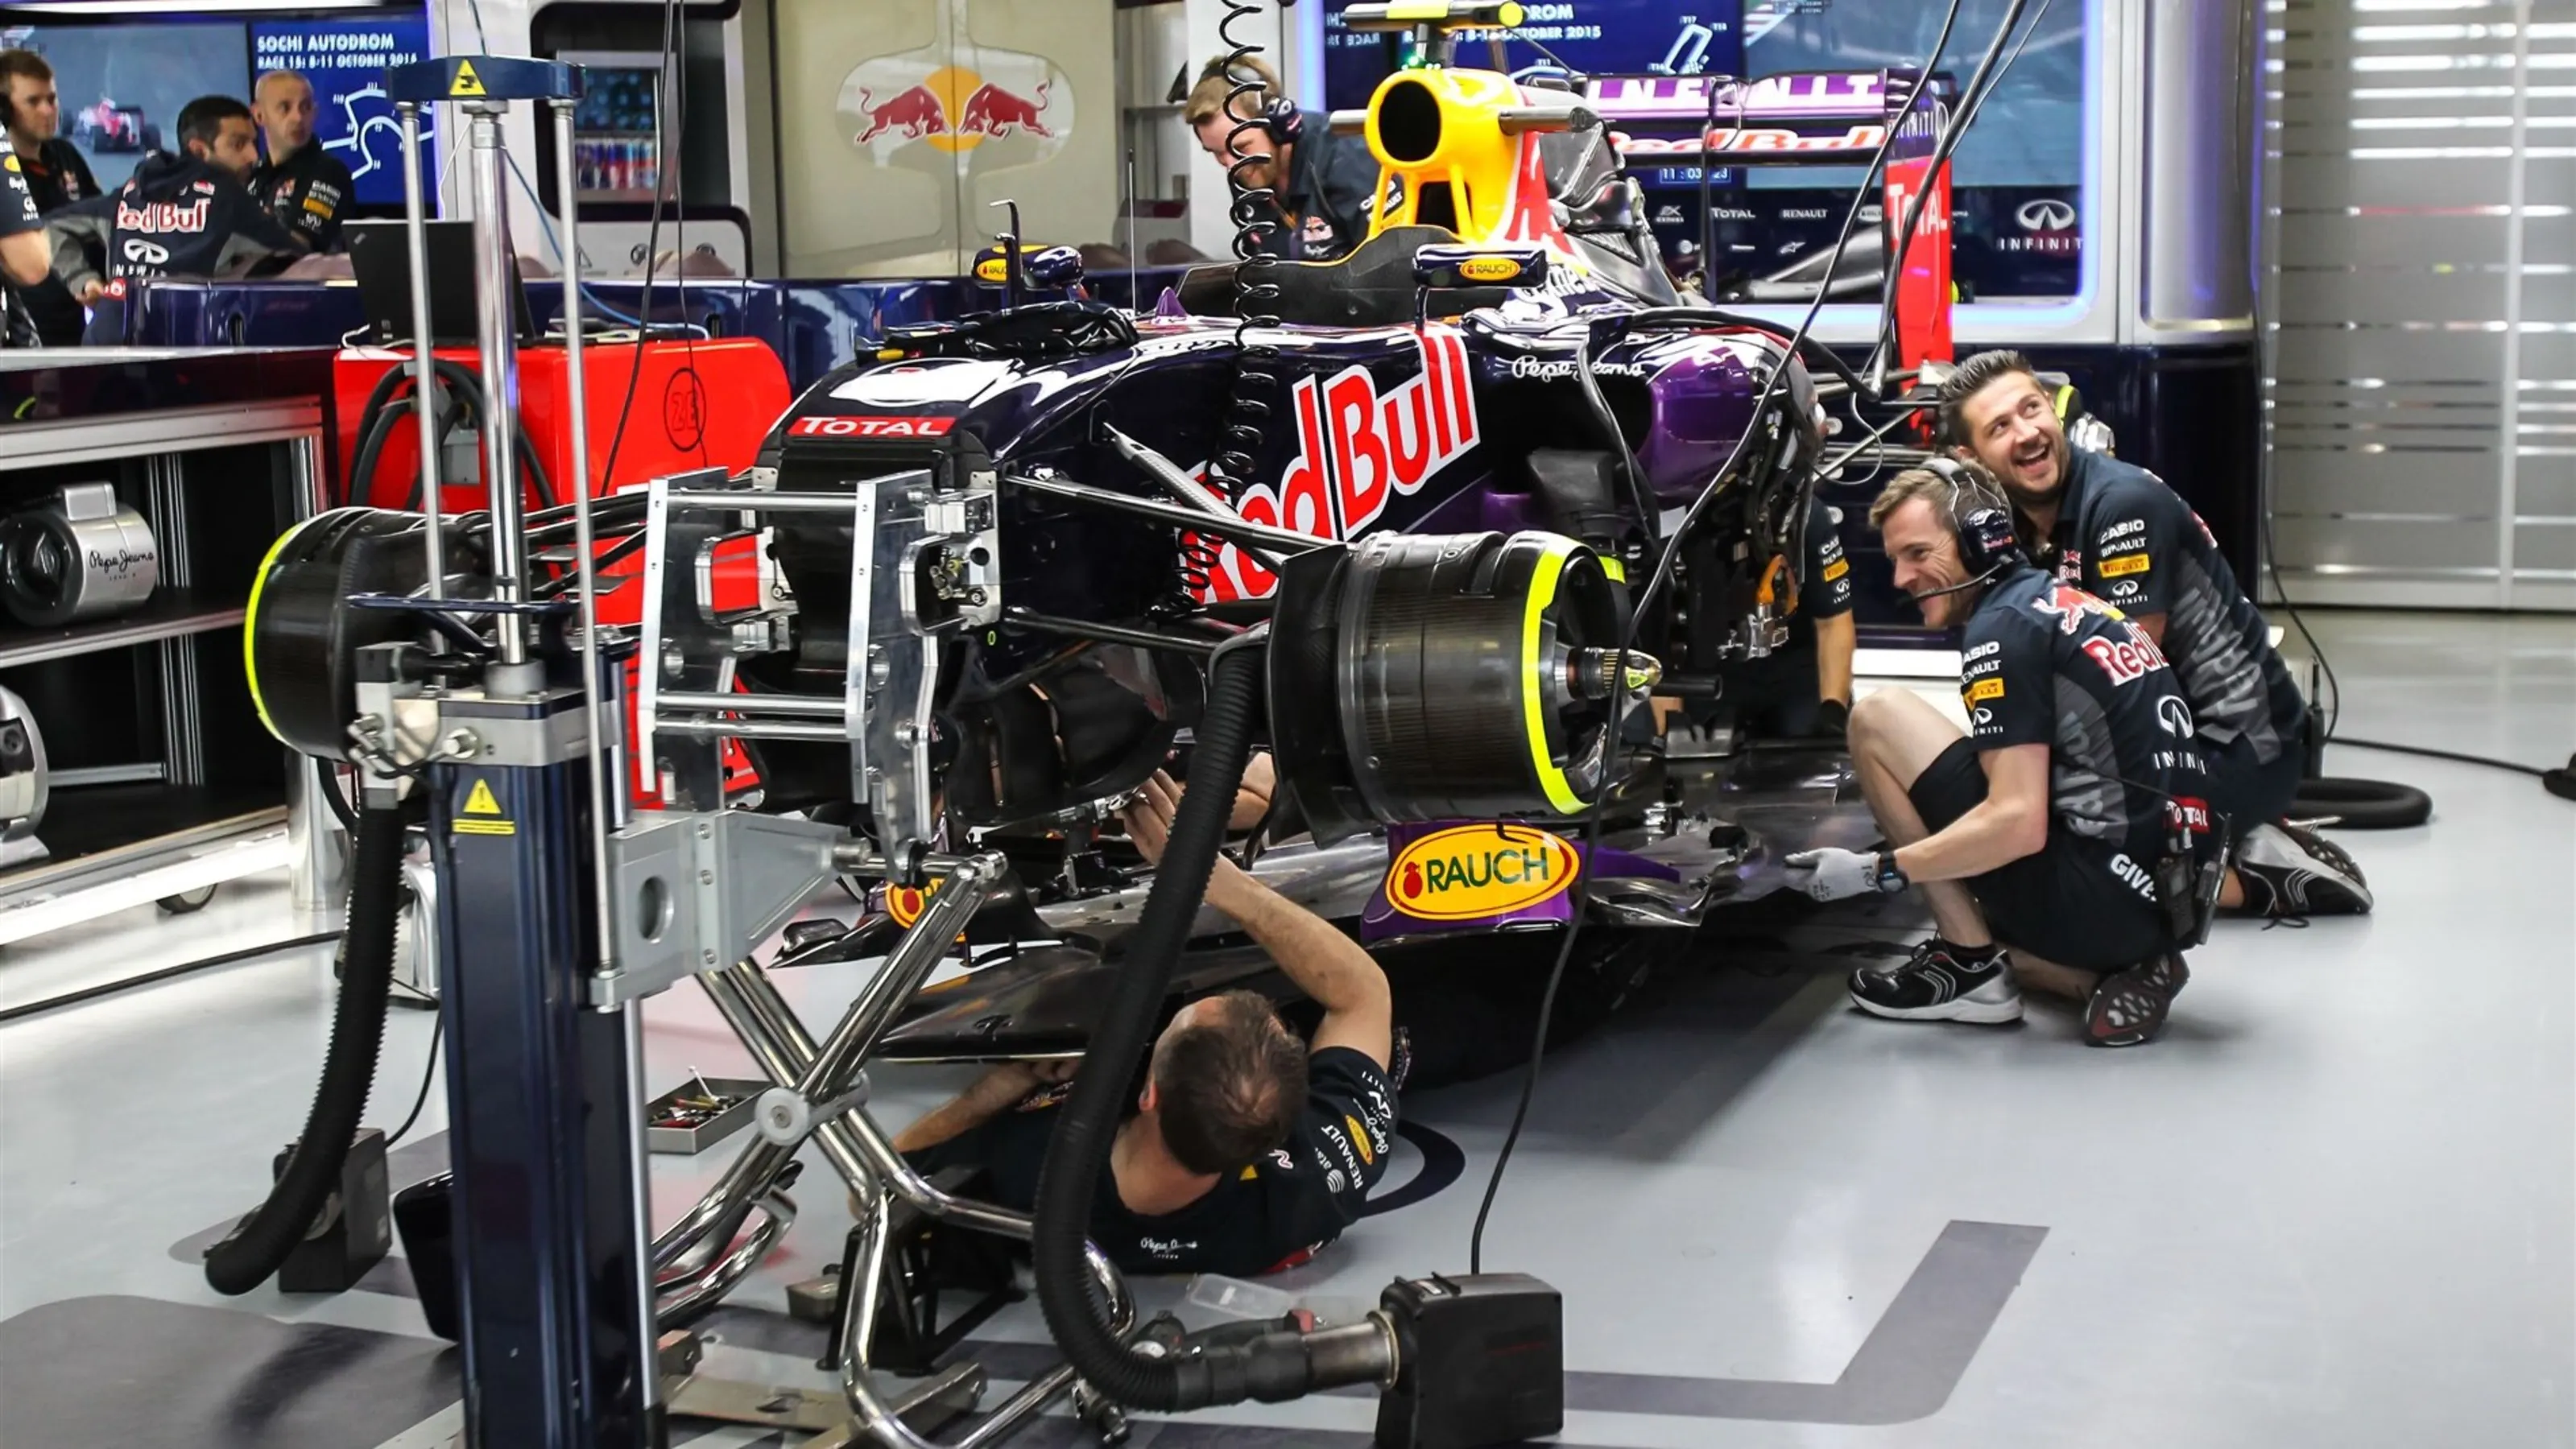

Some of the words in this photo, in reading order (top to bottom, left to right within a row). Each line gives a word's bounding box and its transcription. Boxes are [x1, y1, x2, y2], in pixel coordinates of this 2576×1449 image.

[258, 35, 303, 52] SOCHI
[308, 33, 395, 52] AUTODROM
[1566, 26, 1602, 39] 2015
[337, 53, 386, 68] OCTOBER
[1710, 207, 1755, 218] TOTAL
[1782, 208, 1827, 219] RENAULT
[1475, 264, 1513, 275] RAUCH
[1512, 355, 1572, 382] Pepe
[801, 416, 944, 436] TOTAL
[1322, 317, 1481, 543] Bull
[1964, 641, 2000, 665] ASIO
[2082, 621, 2163, 687] Red
[1962, 660, 2002, 686] ENAULT
[1426, 847, 1548, 894] RAUCH
[2110, 853, 2157, 902] GIVE
[1321, 1125, 1363, 1190] RENAULT
